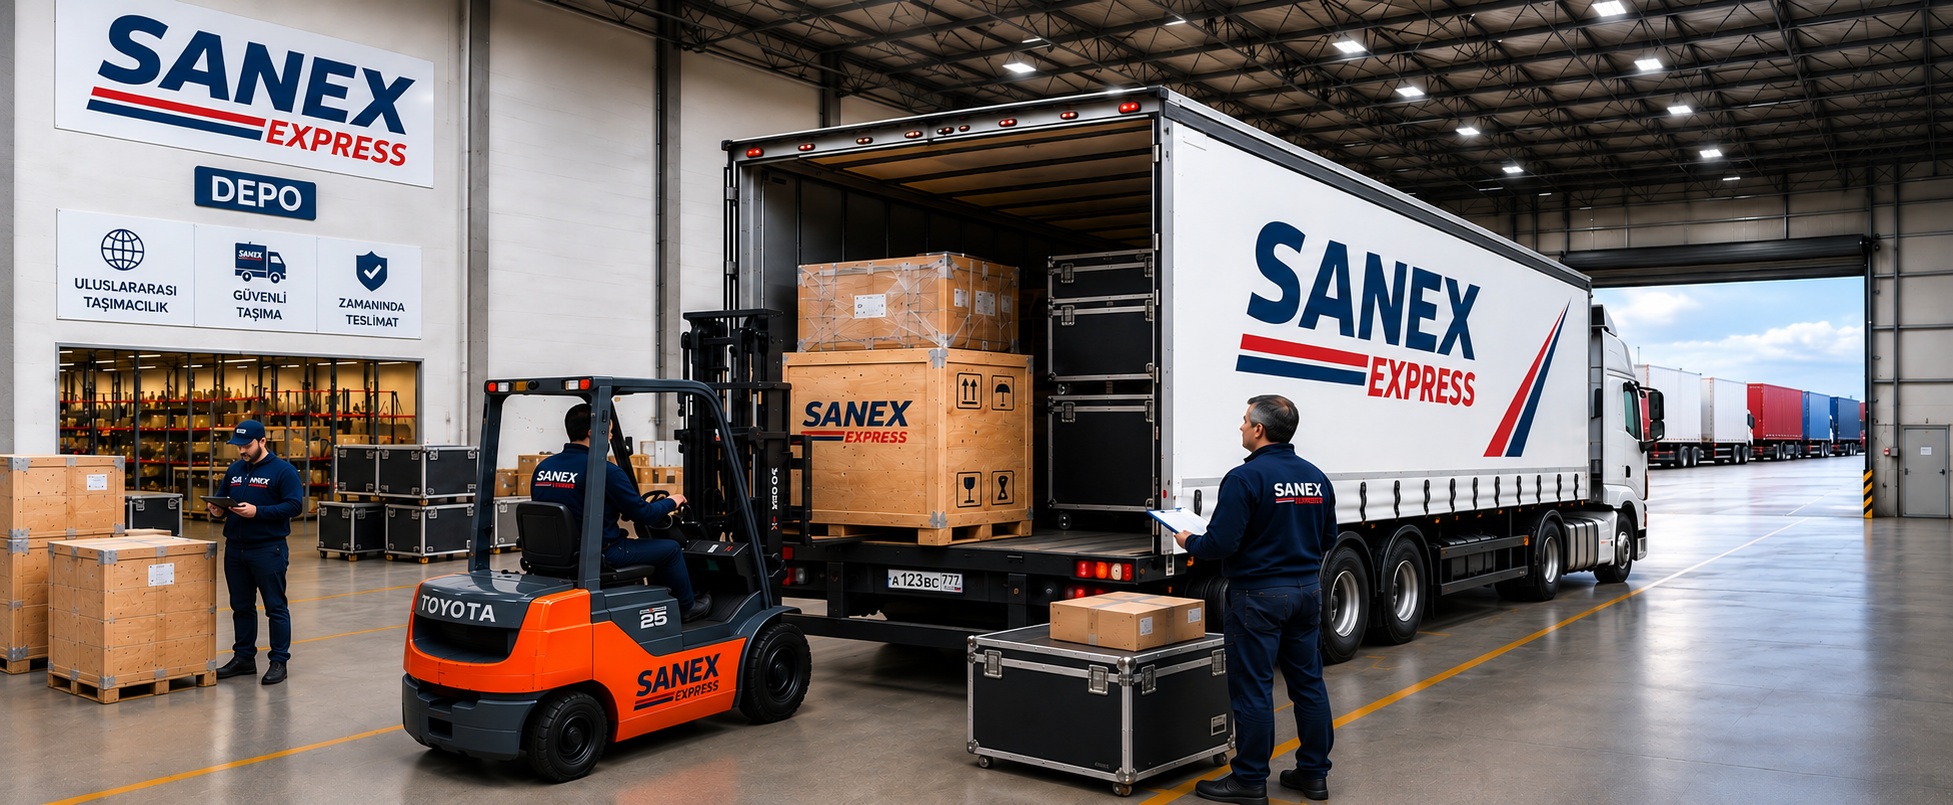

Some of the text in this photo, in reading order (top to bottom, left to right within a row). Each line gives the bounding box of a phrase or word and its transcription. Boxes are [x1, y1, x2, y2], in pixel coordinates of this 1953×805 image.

[97, 14, 416, 136] SANEX
[266, 119, 407, 166] EXPRESS
[211, 175, 302, 212] DEPO
[74, 277, 178, 297] ULUSLARARASI
[233, 288, 287, 304] GÜVENLİ
[1246, 220, 1482, 361] SANEX
[83, 296, 169, 314] TAŞIMACILIK
[236, 306, 283, 322] TAŞIMA
[338, 297, 406, 312] ZAMANINDA
[345, 313, 399, 328] TESLİMAT
[1367, 354, 1476, 408] EXPRESS
[802, 400, 913, 427] SANEX
[845, 431, 908, 444] EXPRESS
[536, 470, 579, 484] SANEX
[1273, 482, 1323, 497] SANEX
[942, 574, 959, 585] 777
[421, 594, 496, 623] TOYOTA
[640, 611, 668, 630] 25
[635, 652, 721, 697] SANEX
[675, 680, 719, 701] EXPRESS
